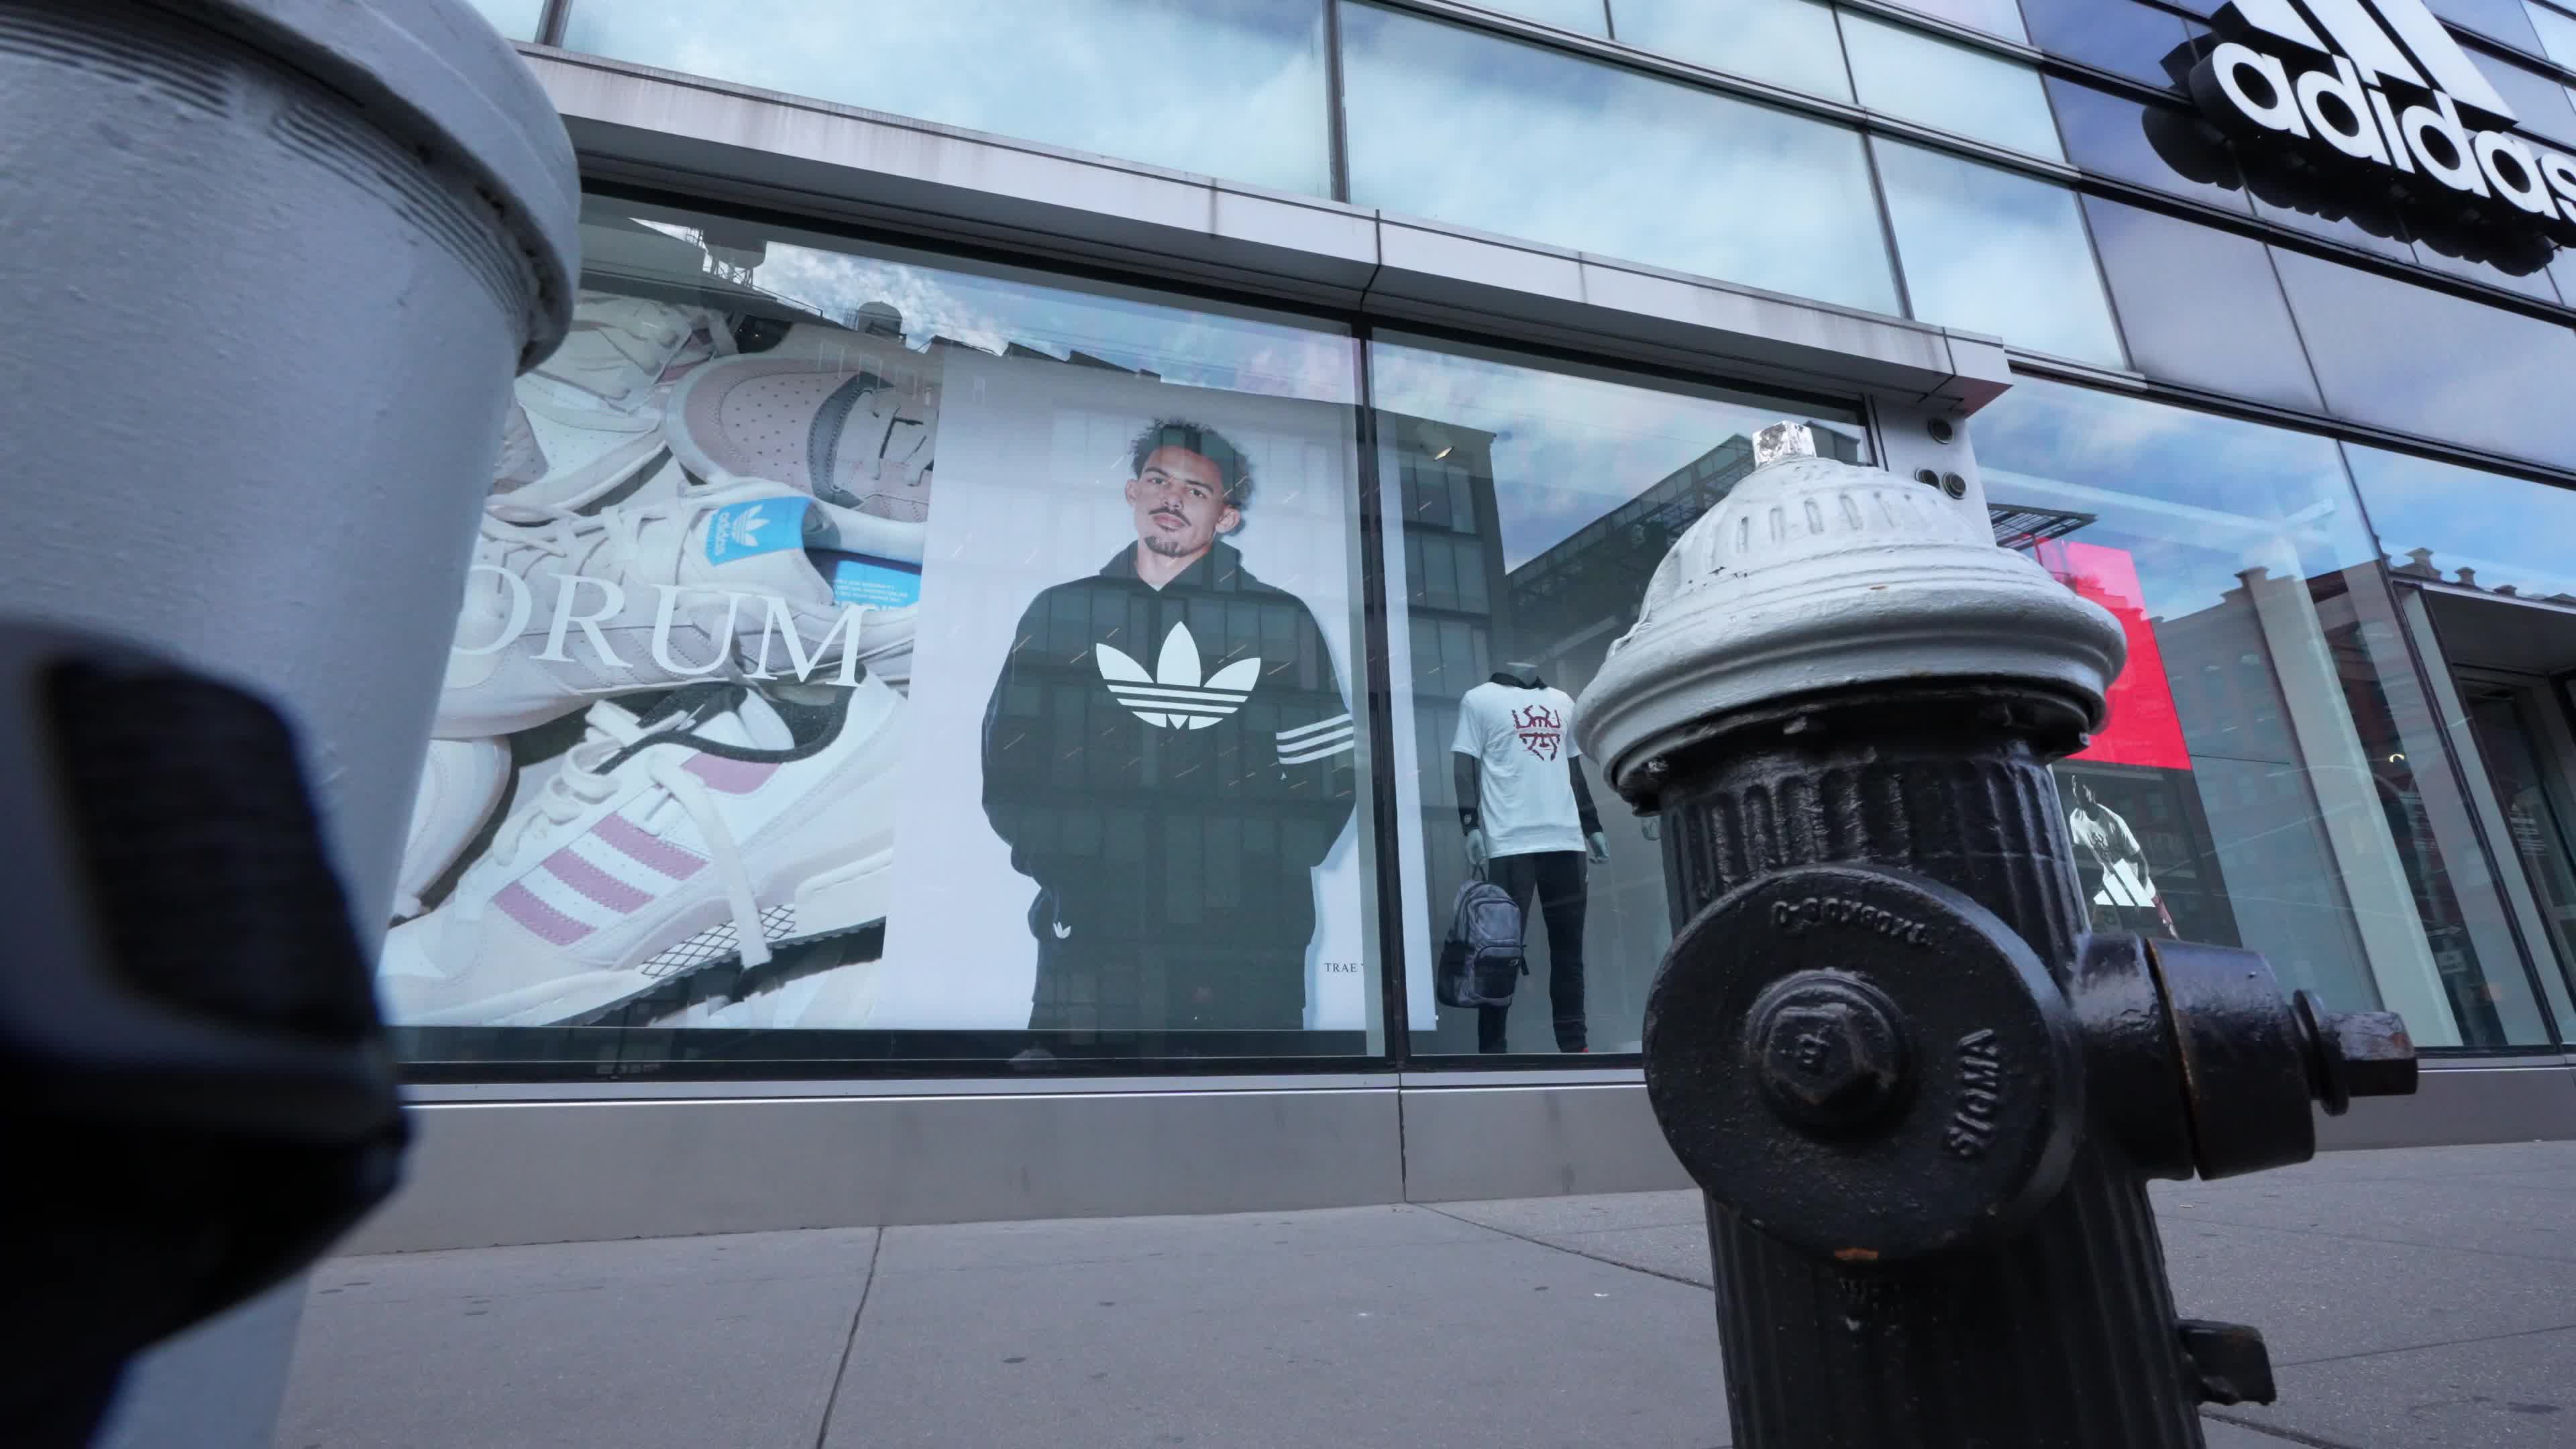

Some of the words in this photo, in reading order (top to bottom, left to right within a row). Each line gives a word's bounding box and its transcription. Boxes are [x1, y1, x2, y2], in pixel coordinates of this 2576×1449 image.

[451, 565, 876, 688] ORUM
[1324, 963, 1358, 972] TRAE
[1949, 1028, 1999, 1156] SIGMA
